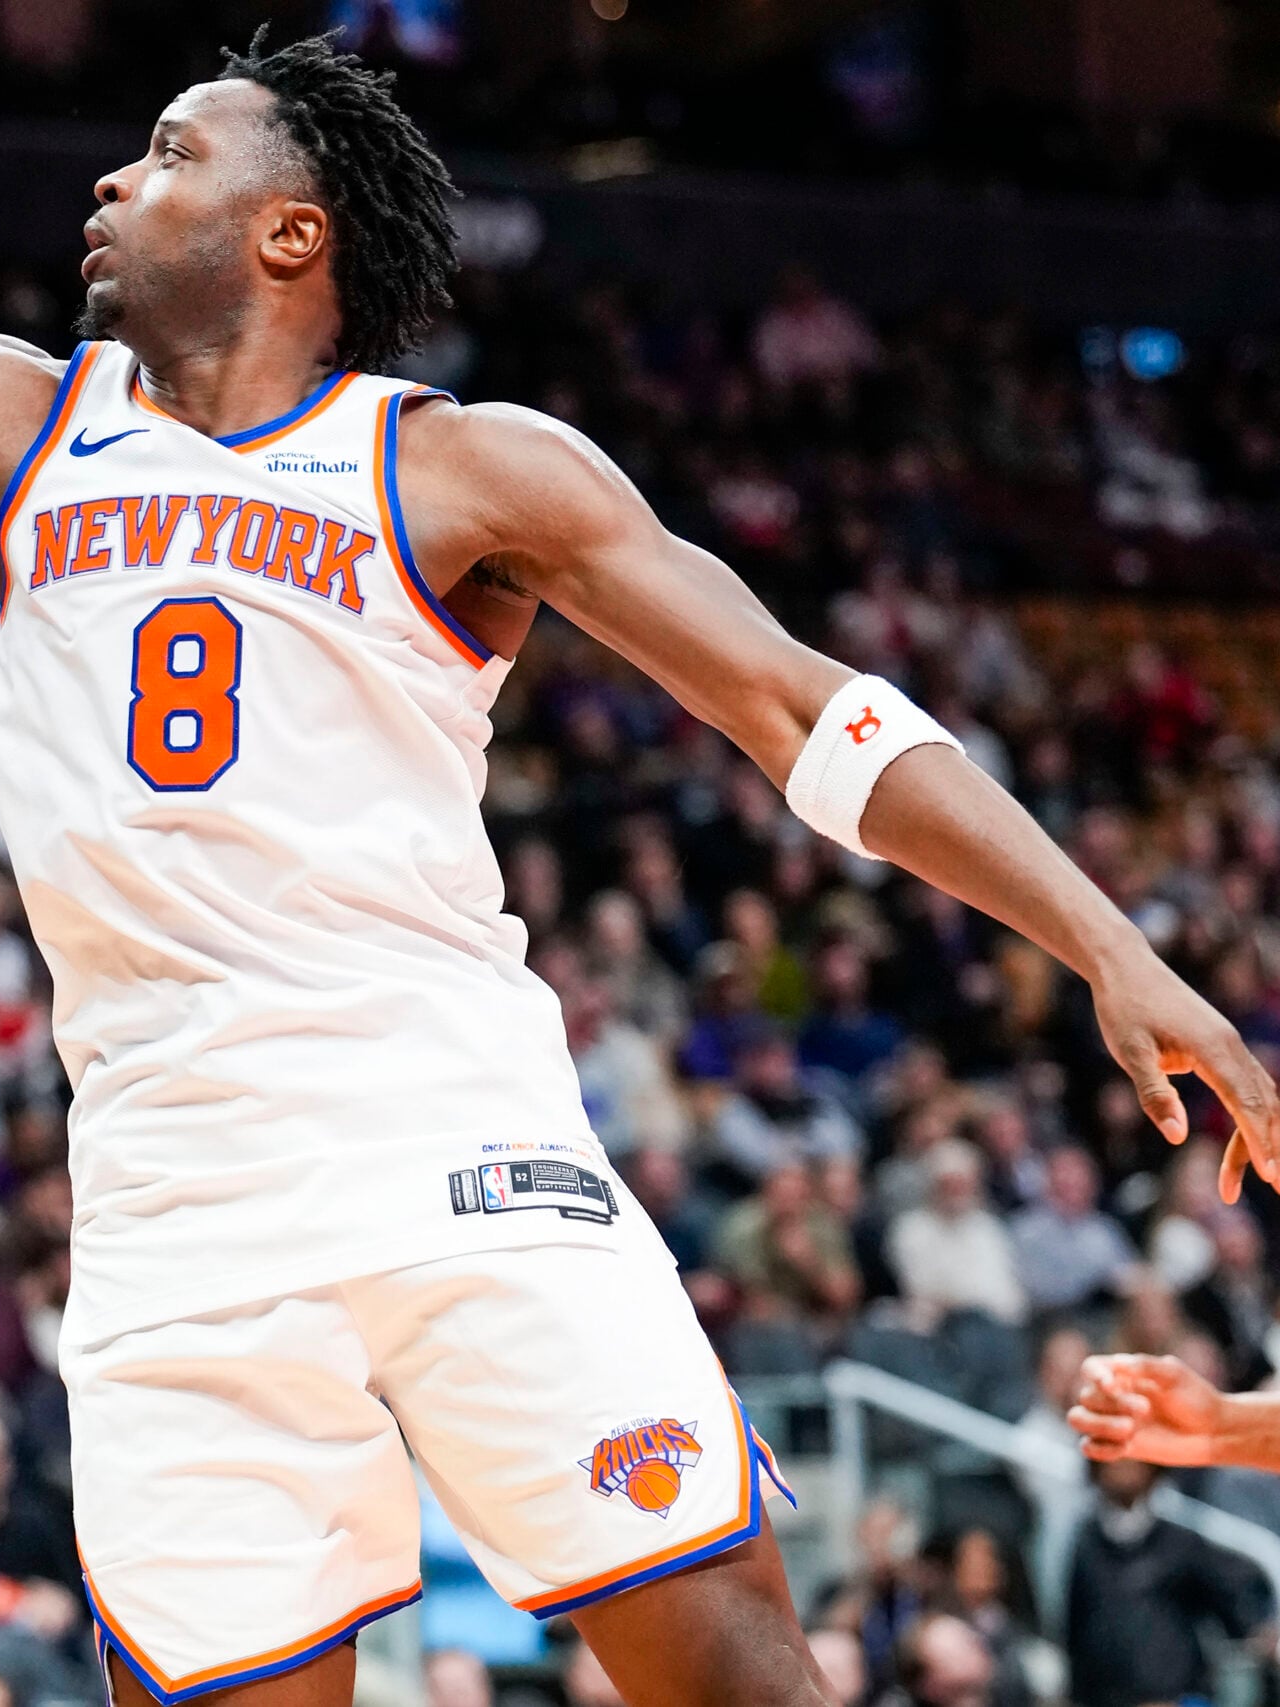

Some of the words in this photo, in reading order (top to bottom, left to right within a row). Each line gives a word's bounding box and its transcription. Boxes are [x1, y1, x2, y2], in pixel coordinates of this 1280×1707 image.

[265, 450, 317, 459] experience
[302, 459, 360, 473] dhabi
[29, 494, 190, 591] NEW
[189, 494, 378, 617] YORK
[127, 596, 243, 792] 8
[482, 1143, 504, 1153] ONCE
[539, 1142, 569, 1153] ALWAYS
[515, 1172, 528, 1182] 52
[610, 1422, 631, 1439] NEW
[631, 1416, 657, 1429] YORK
[590, 1417, 704, 1491] KNICKS
